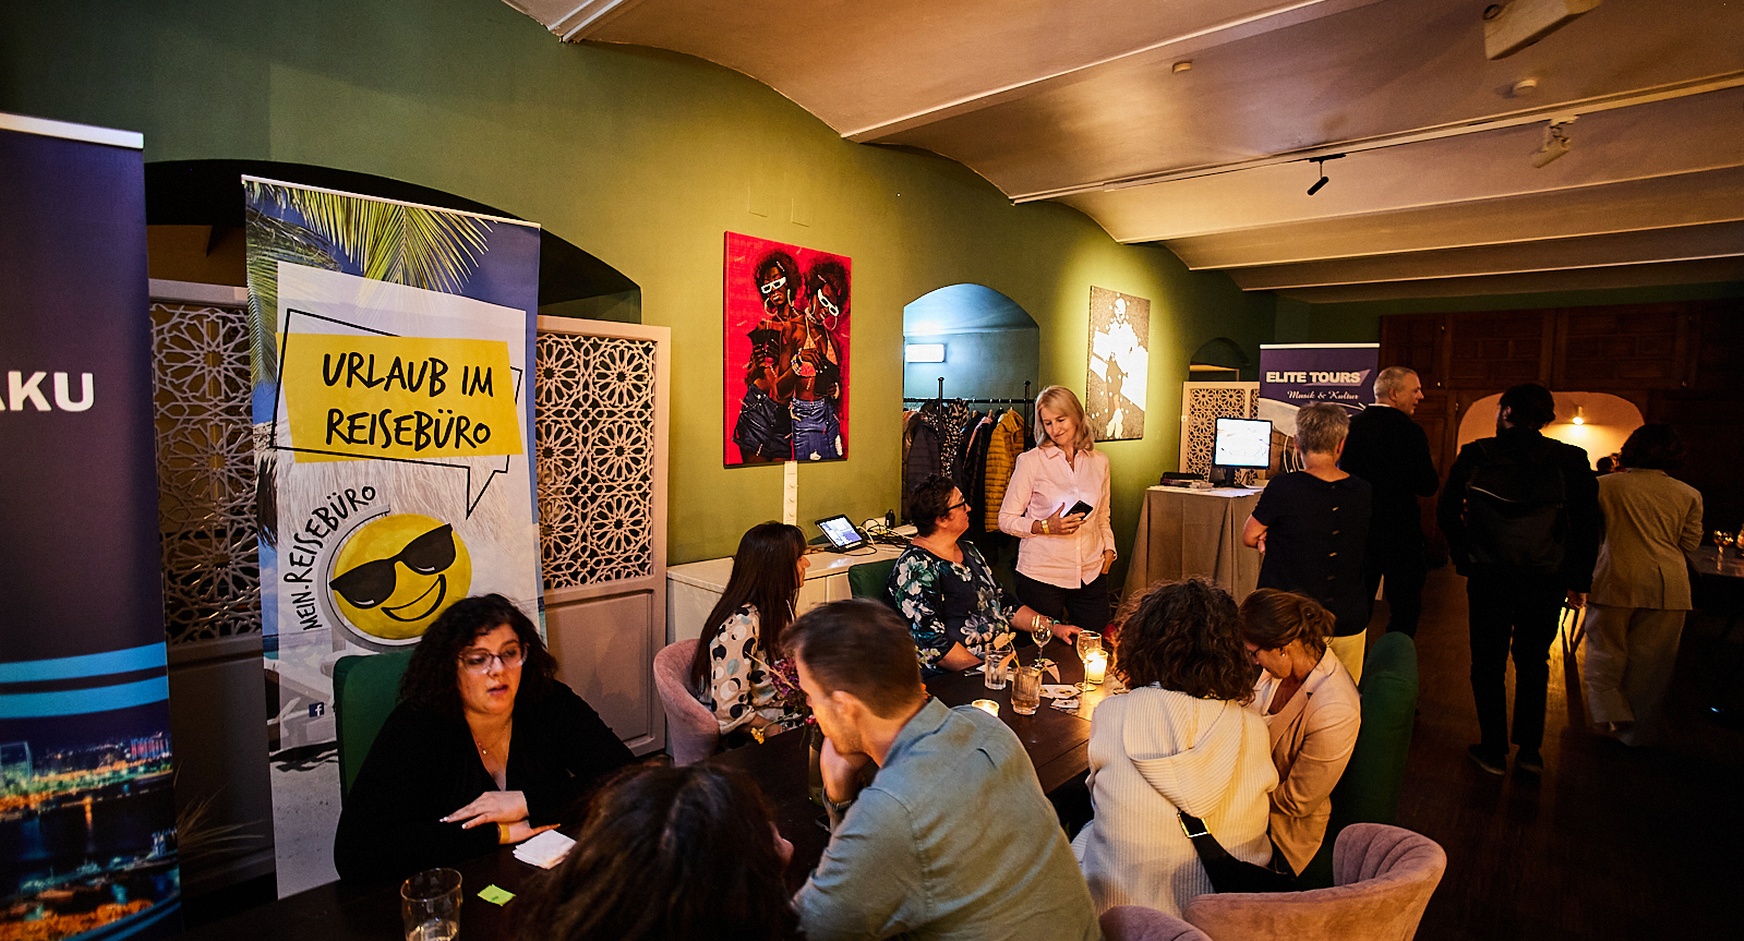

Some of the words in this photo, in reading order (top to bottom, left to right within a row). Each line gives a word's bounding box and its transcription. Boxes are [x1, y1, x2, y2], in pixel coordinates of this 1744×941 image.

[0, 370, 95, 412] KU
[322, 351, 449, 398] URLAUB
[461, 365, 494, 398] IM
[1266, 371, 1307, 383] ELITE
[1309, 371, 1361, 384] TOURS
[1287, 390, 1316, 400] Musik
[1317, 391, 1327, 400] &
[1328, 389, 1359, 400] Kultur
[325, 408, 491, 451] REISEBÜRO
